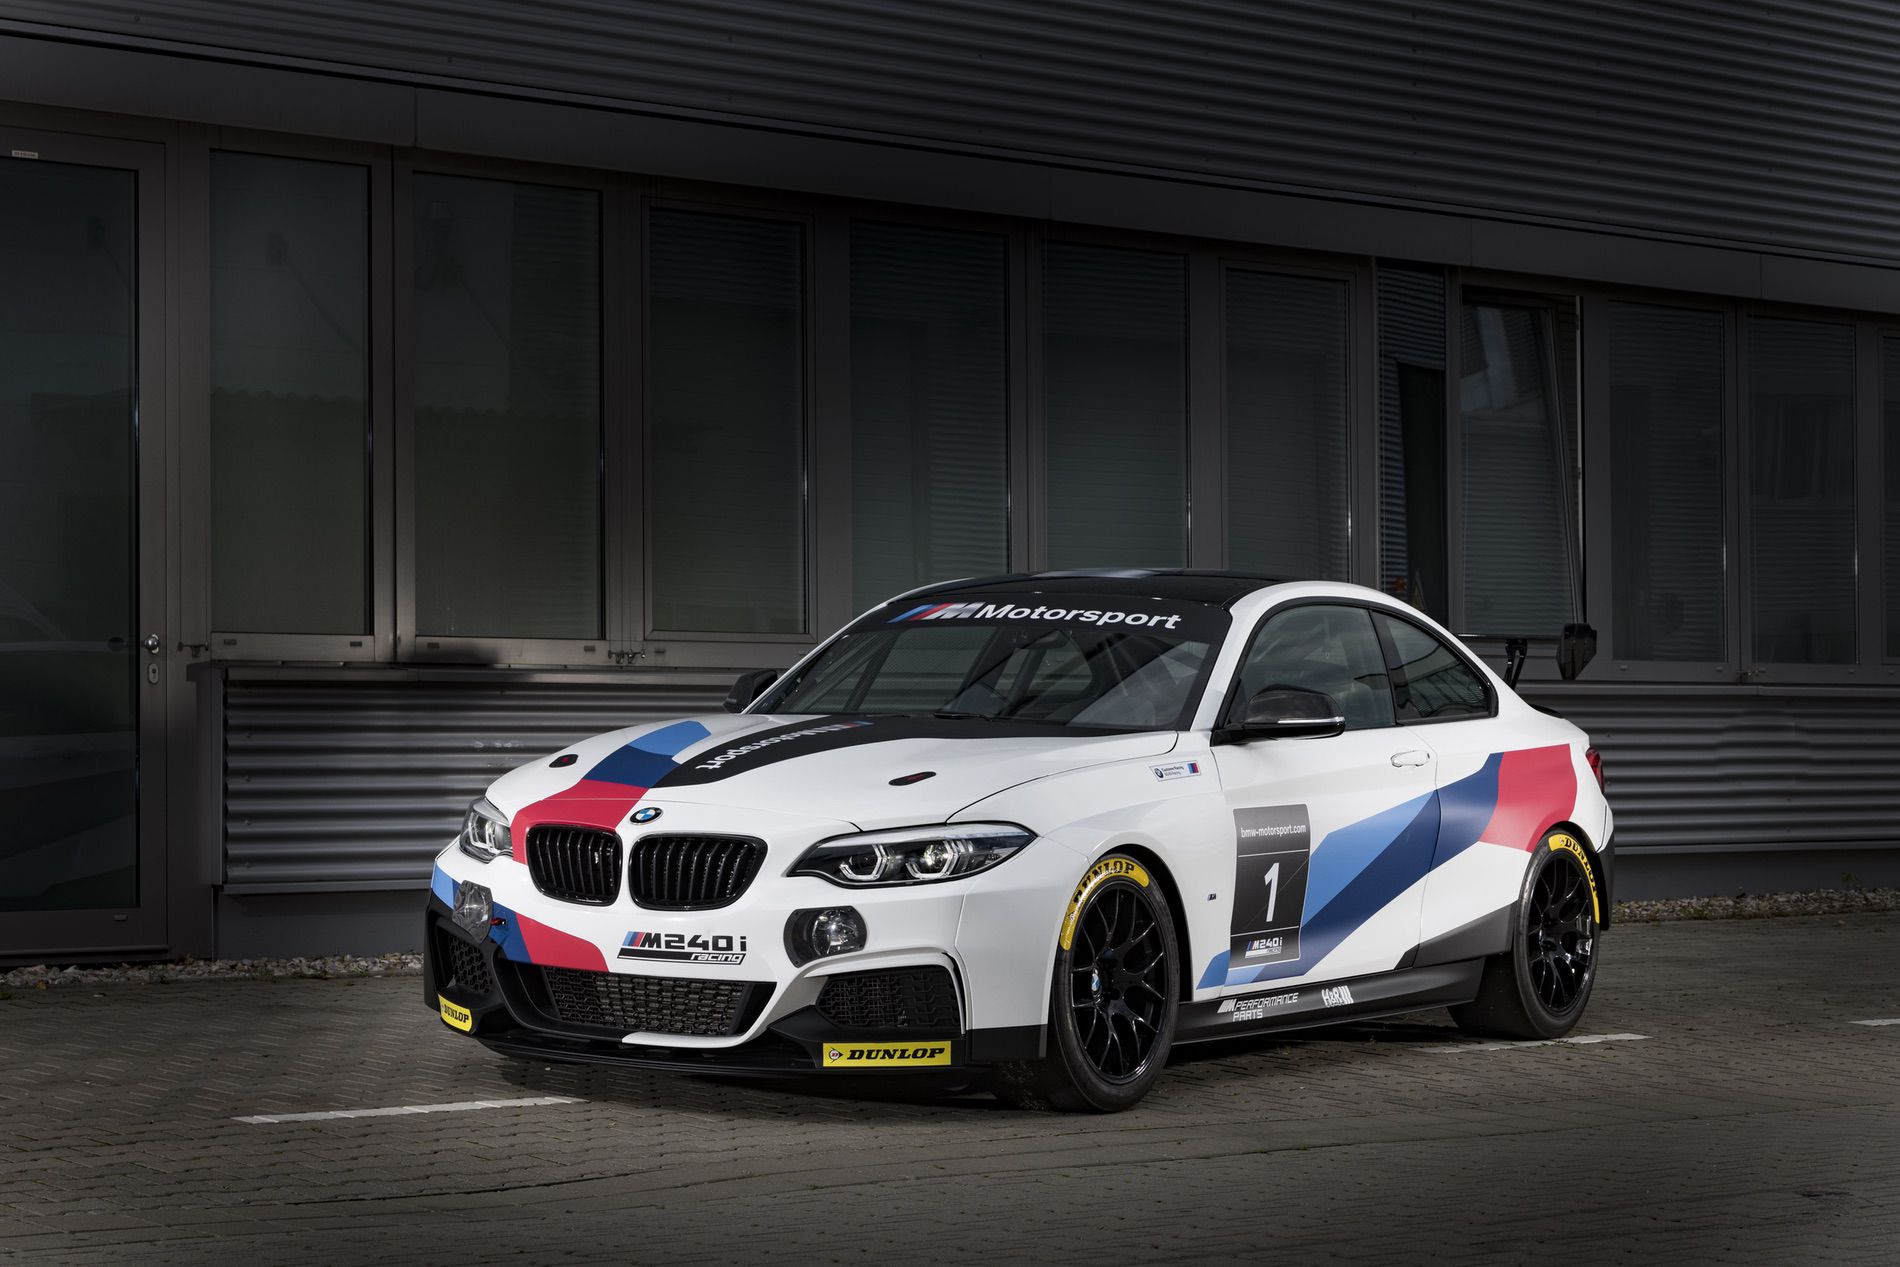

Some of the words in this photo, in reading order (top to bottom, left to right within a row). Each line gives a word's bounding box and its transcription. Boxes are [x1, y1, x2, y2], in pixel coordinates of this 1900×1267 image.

[974, 604, 1181, 629] Motorsport
[1240, 824, 1306, 838] bmw-motorsport.com
[1264, 862, 1280, 922] 1
[690, 953, 744, 963] racing
[1234, 992, 1299, 1011] PERFORMANCE
[444, 1004, 469, 1023] DUNLOP
[1232, 1009, 1263, 1022] PARTS
[847, 1047, 945, 1060] DUNLOP
